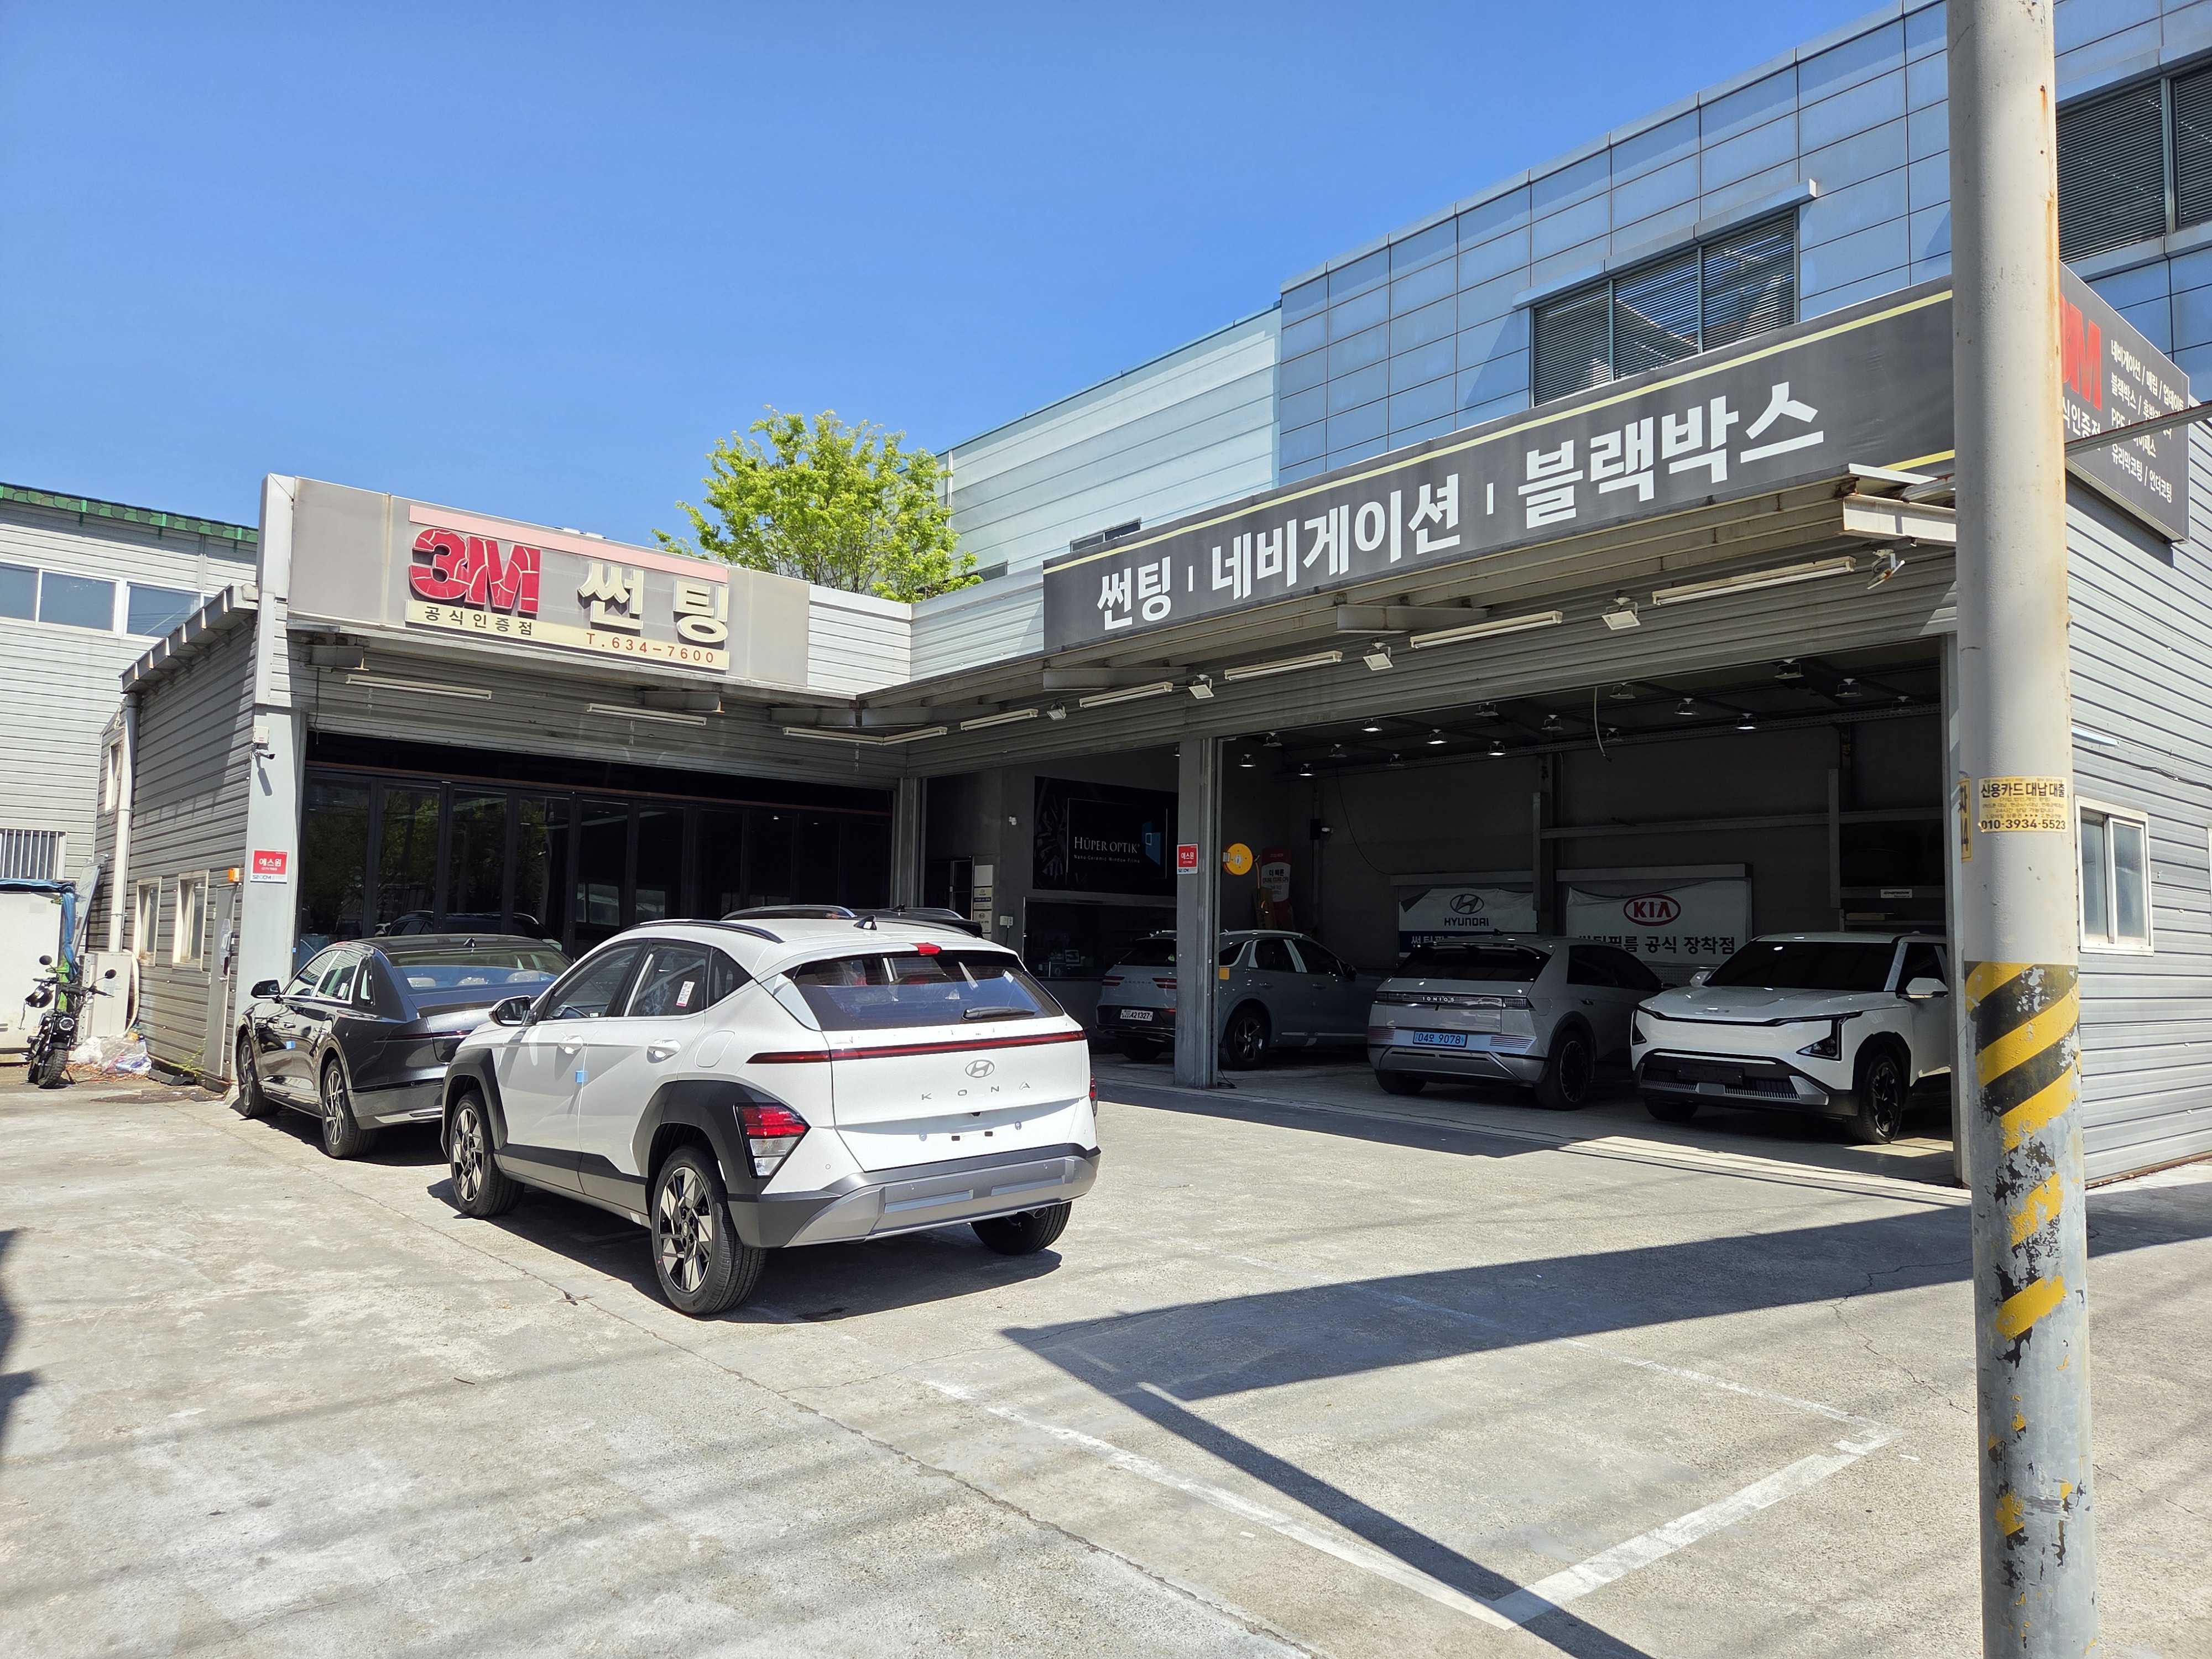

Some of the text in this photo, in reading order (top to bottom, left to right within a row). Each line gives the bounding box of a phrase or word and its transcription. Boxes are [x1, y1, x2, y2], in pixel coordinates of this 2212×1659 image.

[2111, 339, 2141, 382] 네비게이션
[2163, 384, 2184, 411] 업데이트
[2111, 372, 2137, 410] 블랙박스
[2111, 444, 2143, 482] 유리막코팅
[2149, 469, 2172, 504] 언더코팅
[1097, 556, 1171, 631] 썬팅
[1212, 472, 1461, 601] 네비게이션
[1517, 381, 1824, 529] 블랙박스
[409, 528, 541, 614] 3M
[424, 605, 714, 664] 공식인증점 T.634-7600
[1980, 782, 2065, 798] 신용카드 대납 대출
[1981, 818, 2066, 830] 010-3934-5523
[1074, 836, 1108, 851] HÜPER
[258, 858, 282, 867] 에스원
[1633, 901, 1672, 918] KIA
[1444, 917, 1489, 926] HYUNDAI
[1645, 936, 1677, 953] 공식
[1683, 936, 1735, 954] 장착점
[1438, 1034, 1461, 1044] 9078
[921, 1082, 1031, 1100] KONA
